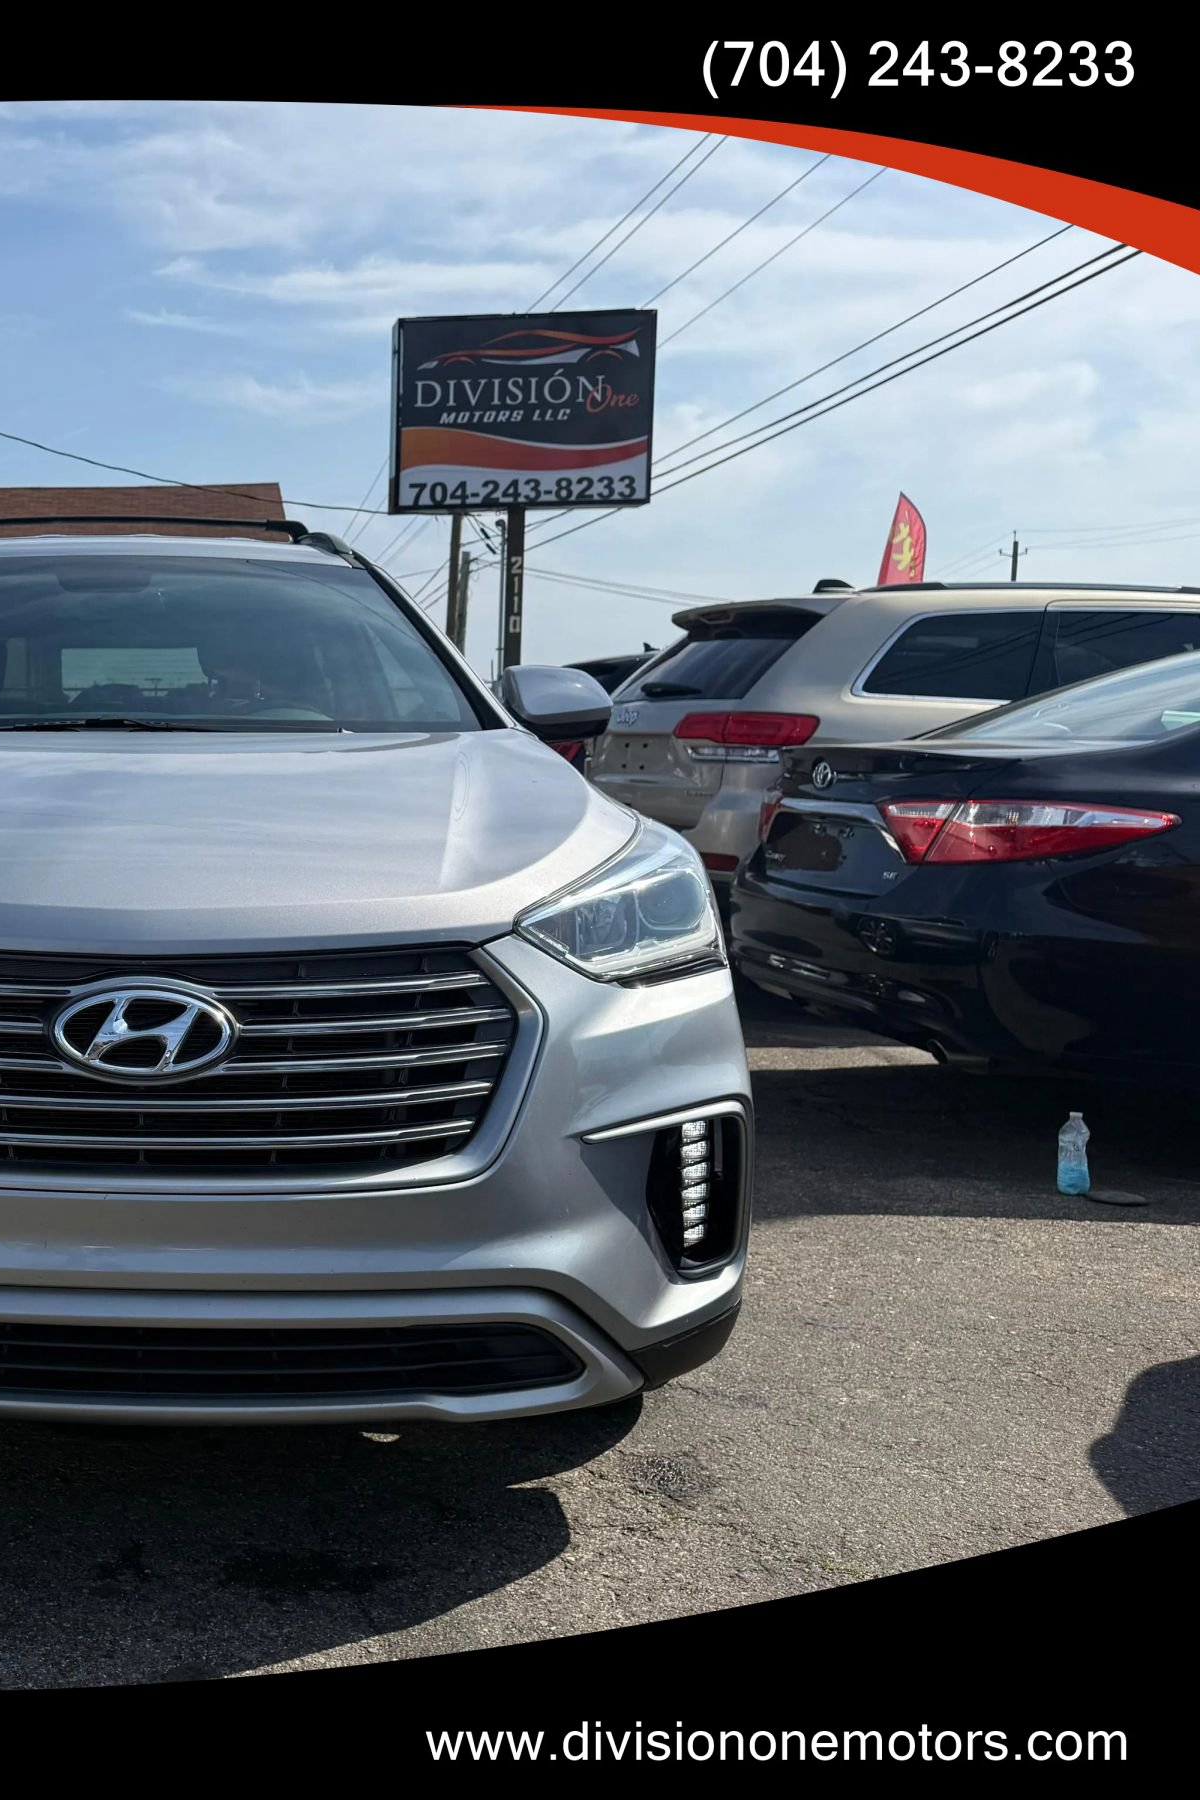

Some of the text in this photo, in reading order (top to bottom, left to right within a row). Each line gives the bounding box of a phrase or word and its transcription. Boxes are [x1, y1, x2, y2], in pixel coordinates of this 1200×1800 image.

[414, 369, 639, 413] DIVISIÓN One
[440, 409, 571, 424] MOTORS LLC
[408, 475, 637, 505] 704-243-8233
[509, 556, 523, 633] 2110
